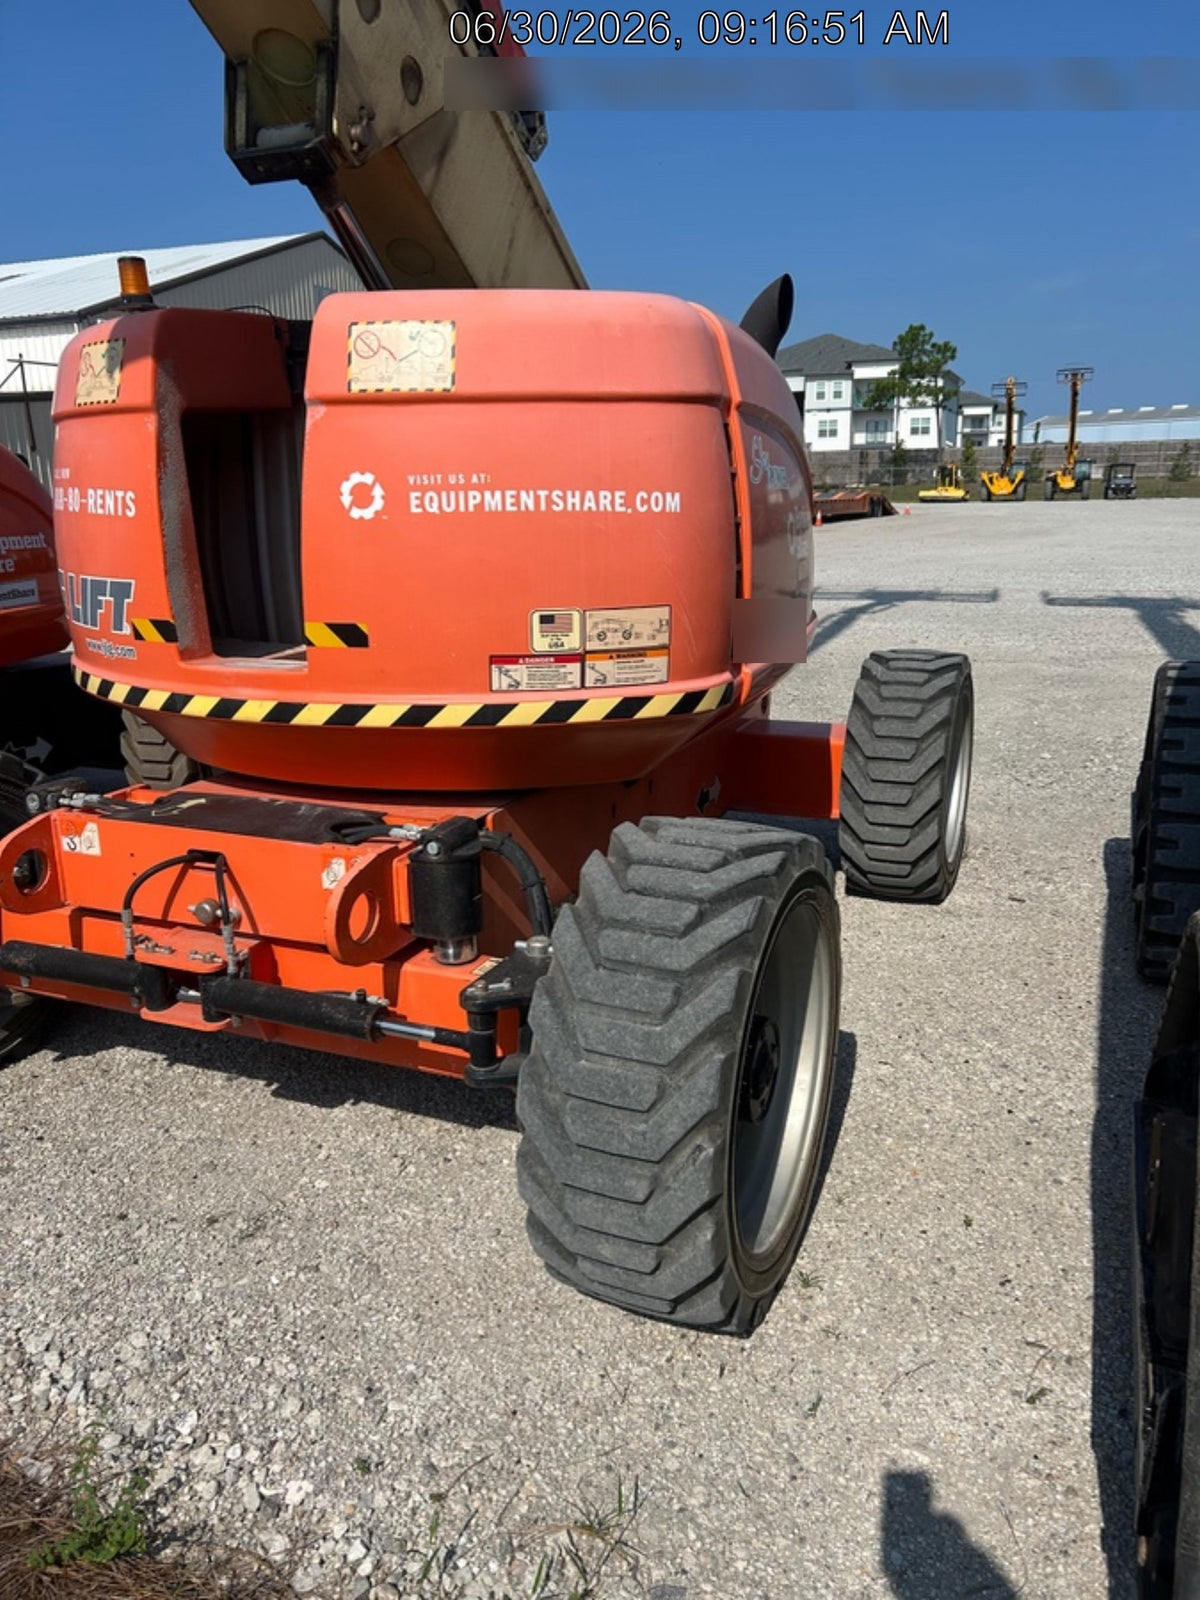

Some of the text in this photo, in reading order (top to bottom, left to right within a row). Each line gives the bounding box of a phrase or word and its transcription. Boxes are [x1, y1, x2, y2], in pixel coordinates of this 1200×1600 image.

[407, 473, 492, 486] VISIT US AT:
[408, 489, 682, 515] EQUIPMENTSHARE.COM
[67, 571, 136, 635] LIFT
